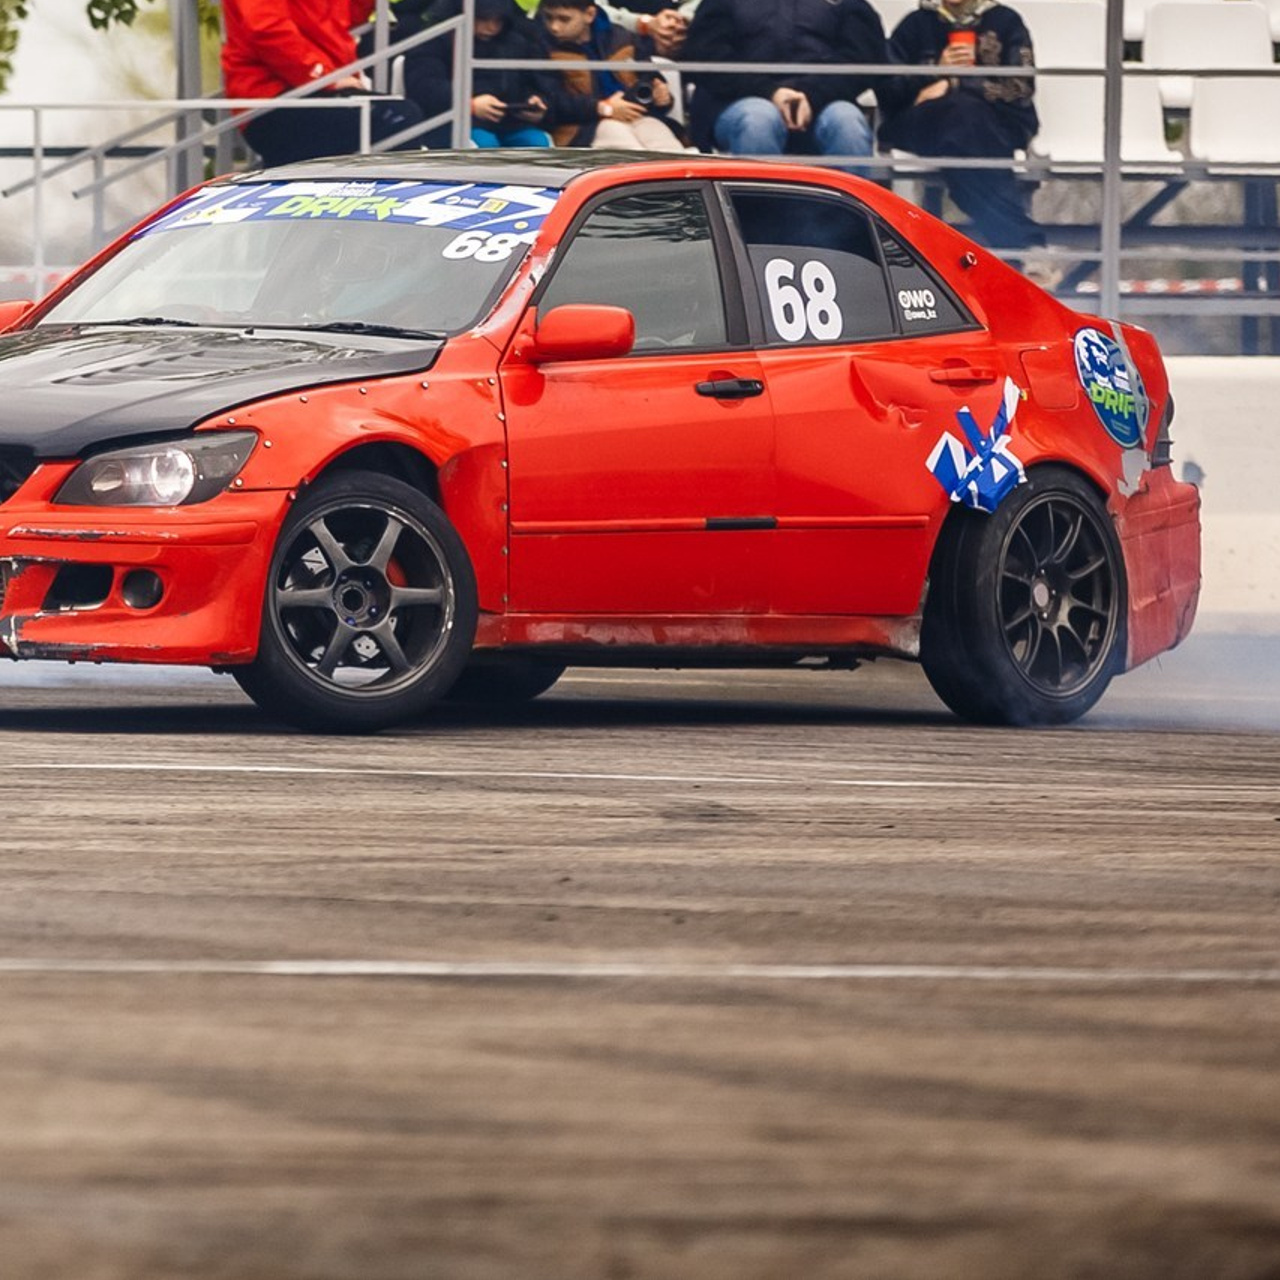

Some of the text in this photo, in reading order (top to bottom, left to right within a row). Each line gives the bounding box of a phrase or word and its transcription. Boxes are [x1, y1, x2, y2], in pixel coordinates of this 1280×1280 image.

[265, 195, 408, 220] DRIFT
[441, 230, 520, 262] 68
[764, 258, 843, 342] 68
[898, 289, 935, 308] OWO
[1089, 380, 1135, 419] DRIF
